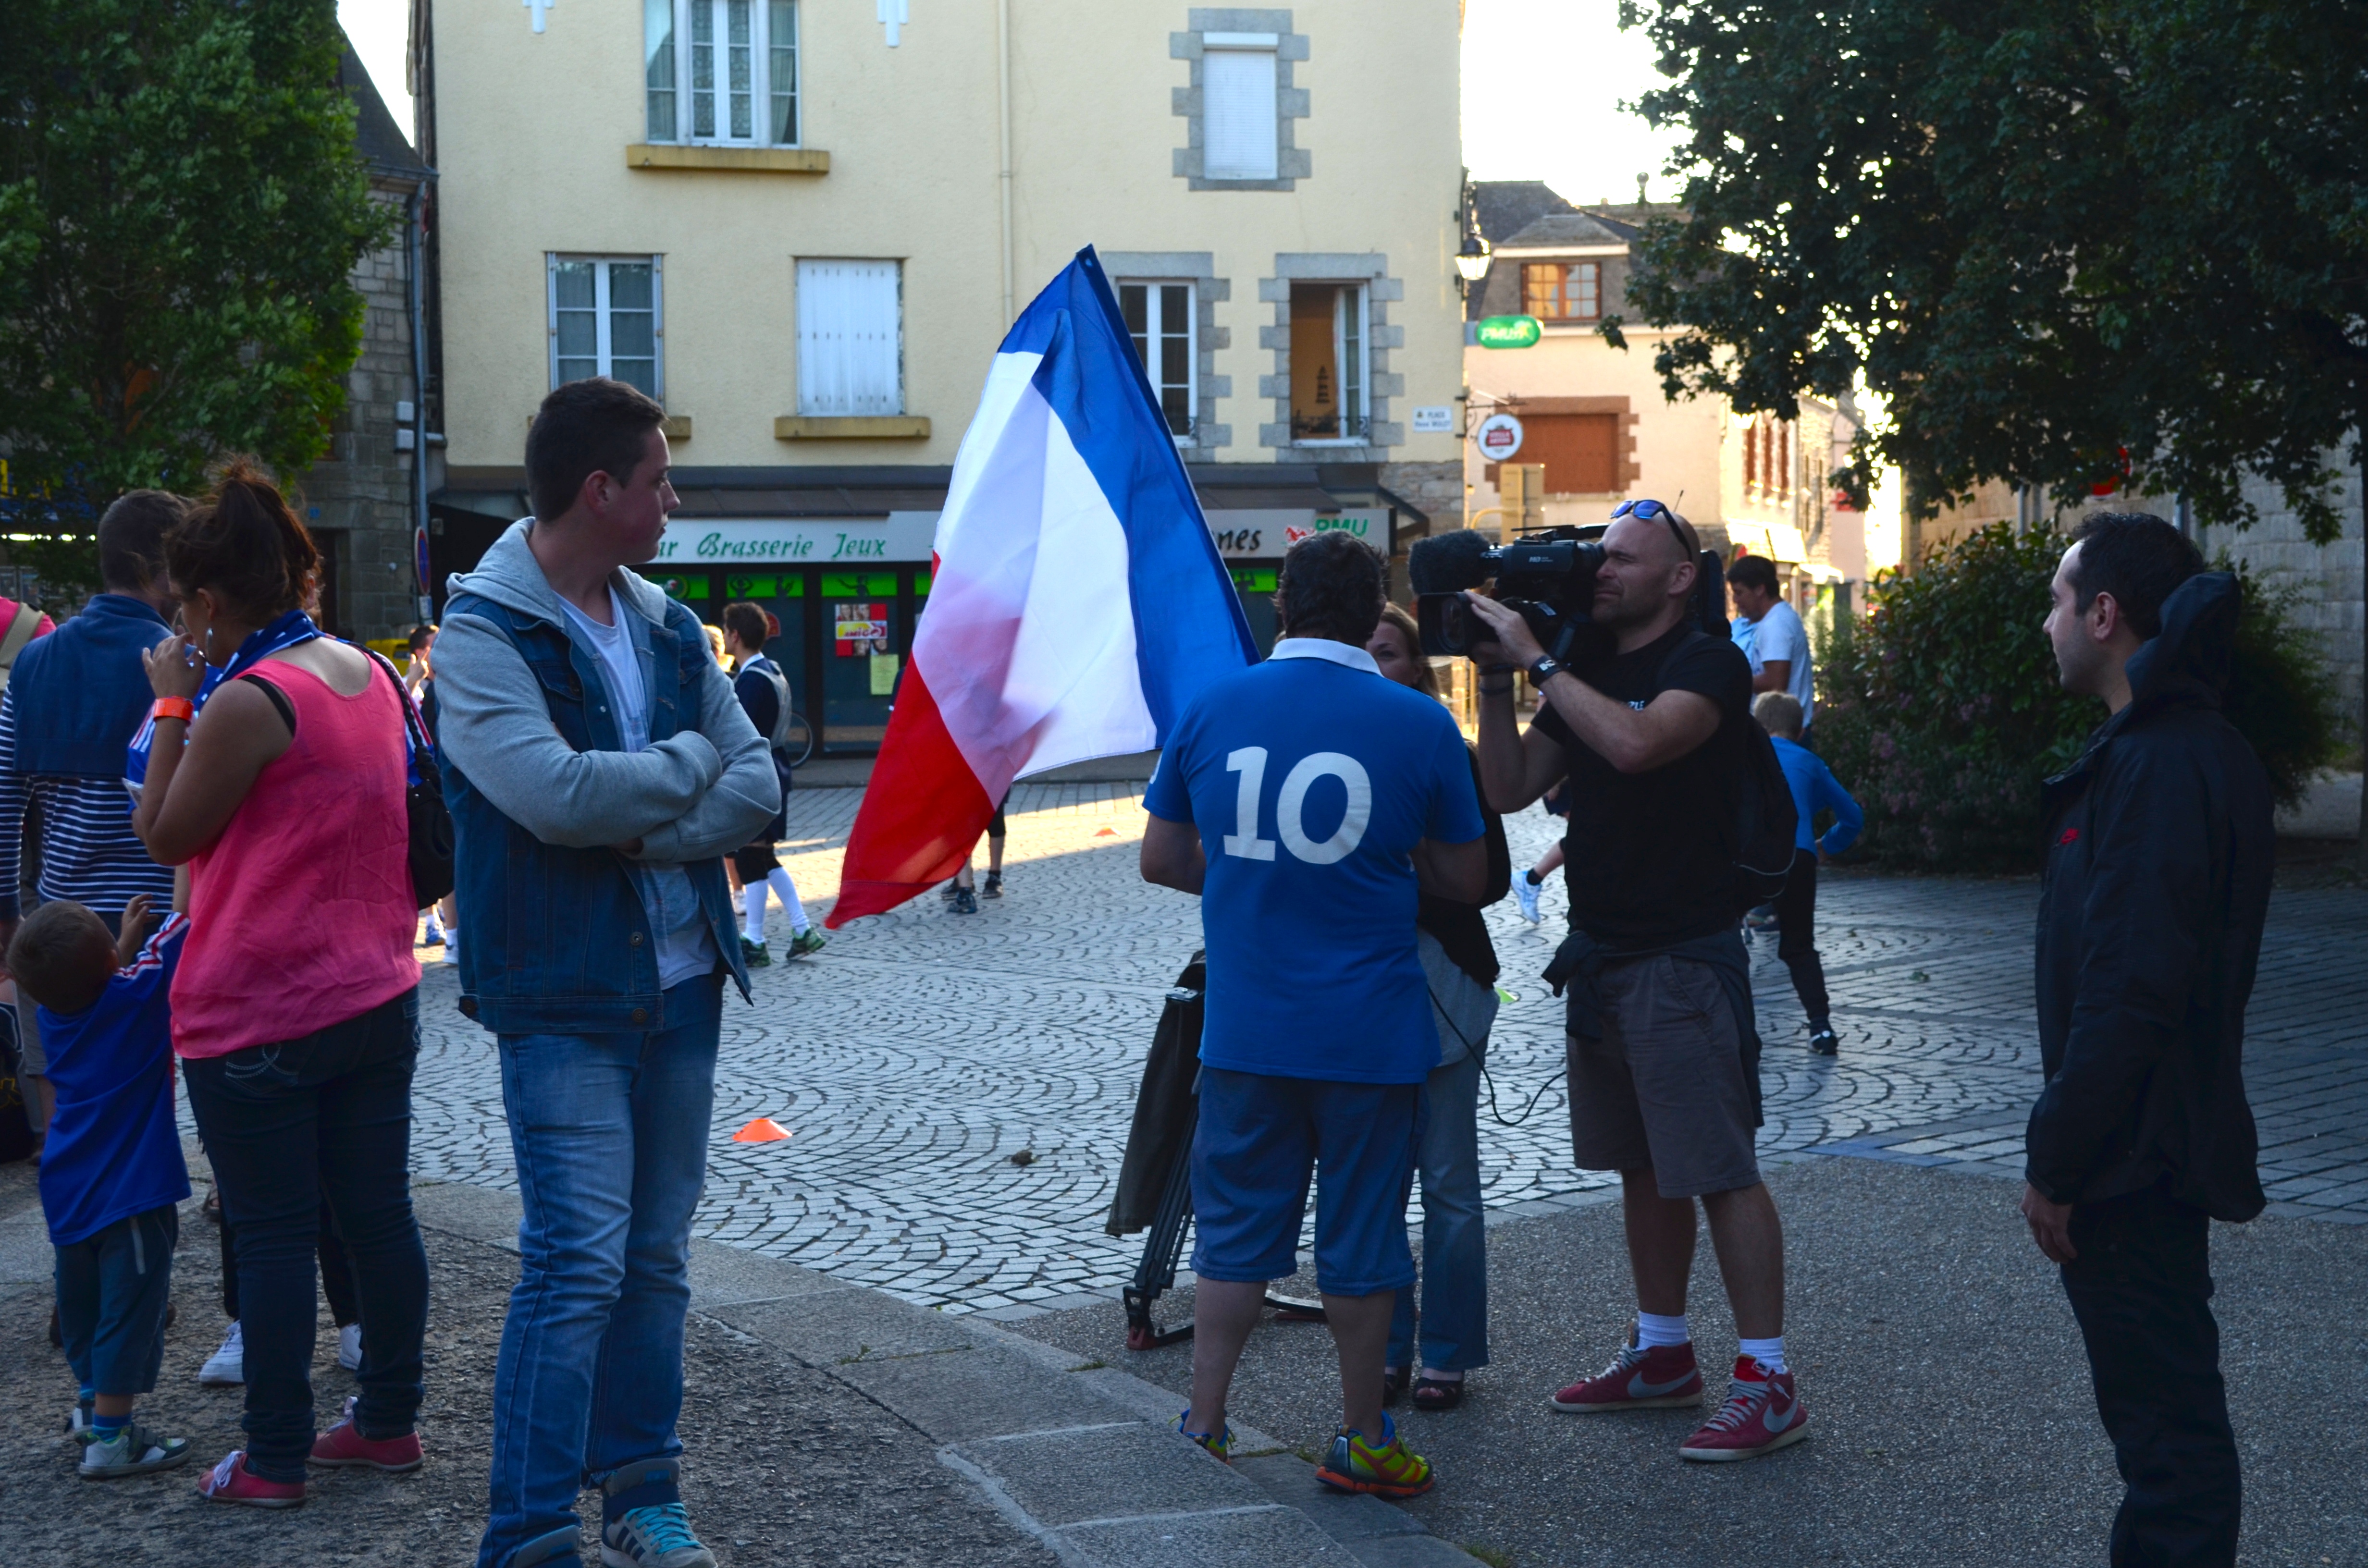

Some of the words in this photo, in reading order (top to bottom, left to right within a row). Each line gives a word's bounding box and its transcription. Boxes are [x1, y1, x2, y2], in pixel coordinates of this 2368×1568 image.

[1315, 518, 1368, 538] PMU
[698, 532, 813, 558] Brasserie
[832, 533, 885, 559] Jeux
[1223, 746, 1372, 865] 10
